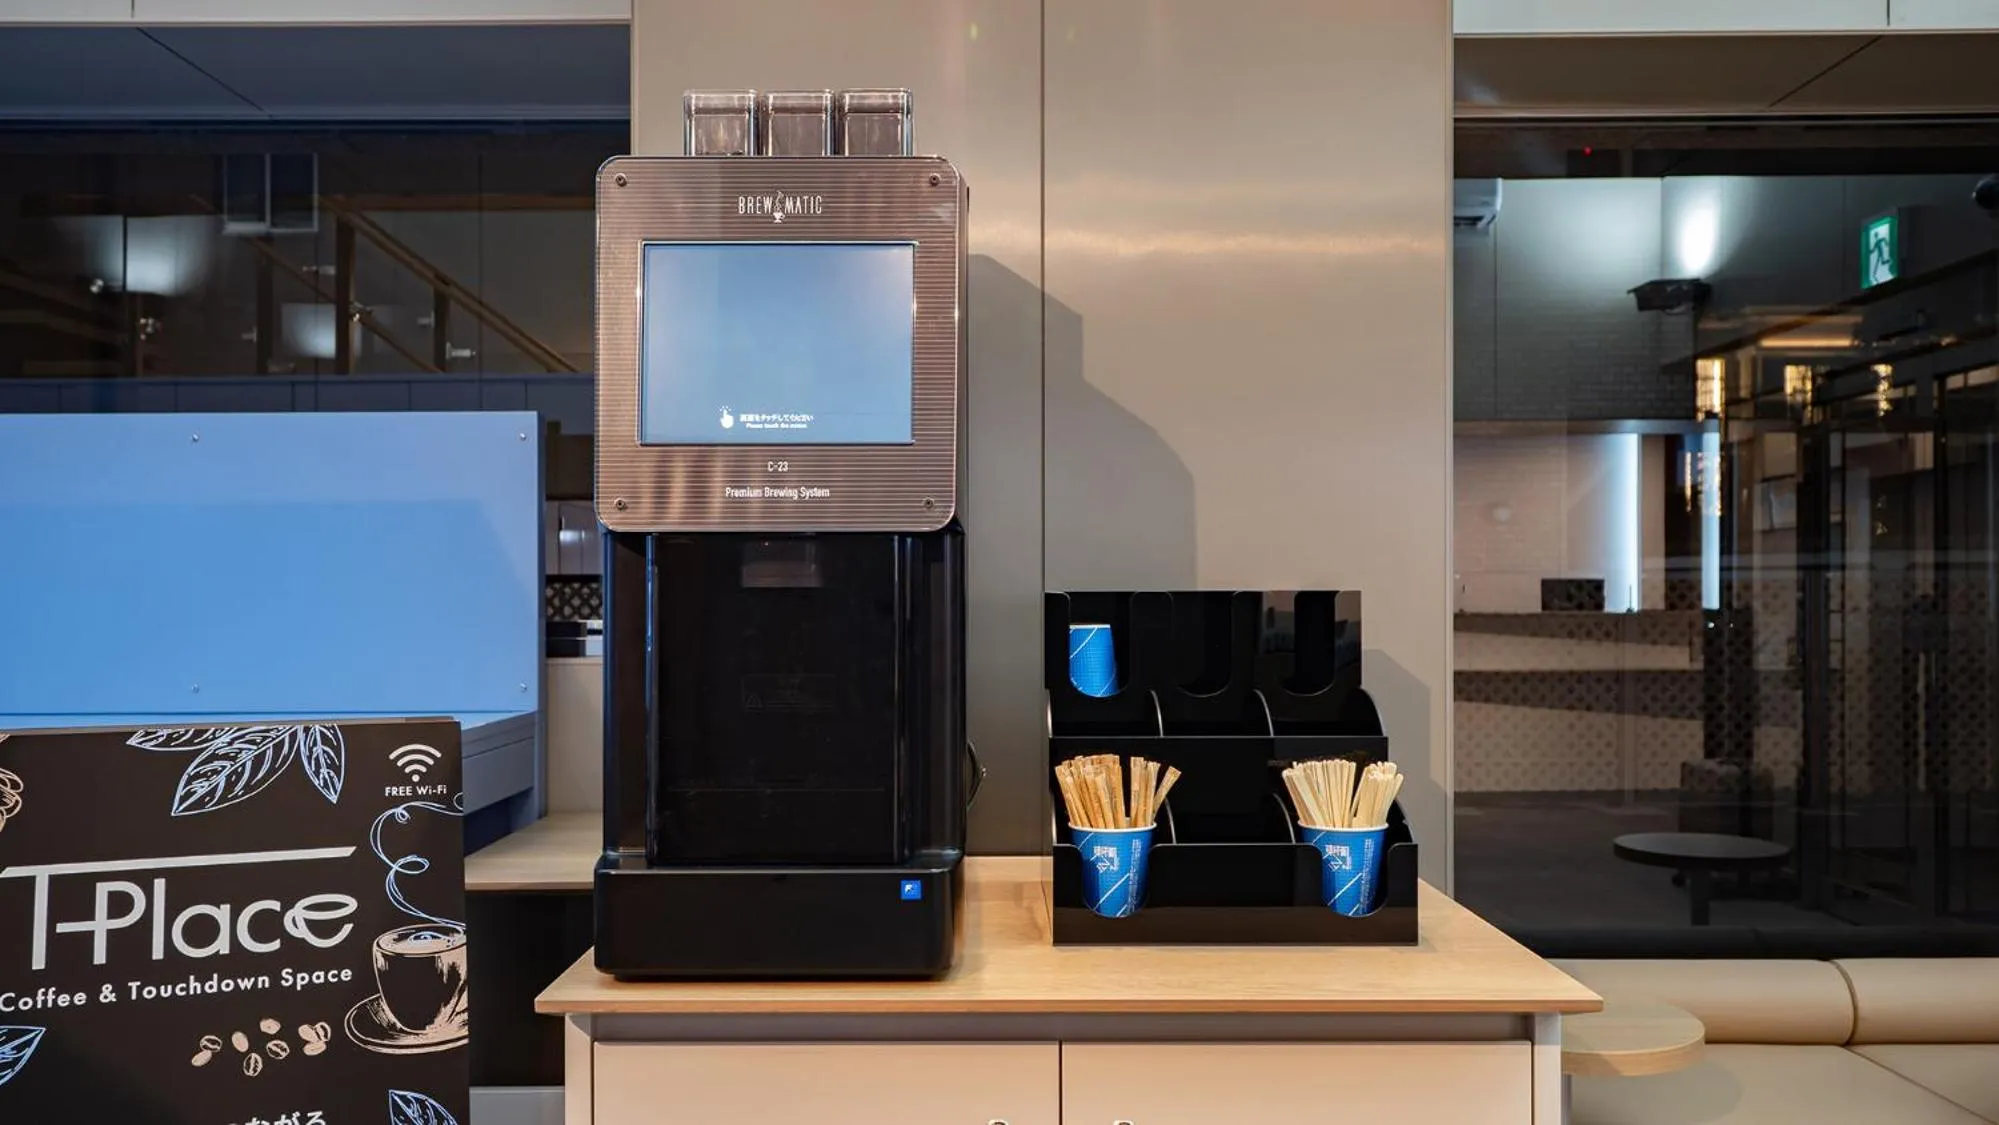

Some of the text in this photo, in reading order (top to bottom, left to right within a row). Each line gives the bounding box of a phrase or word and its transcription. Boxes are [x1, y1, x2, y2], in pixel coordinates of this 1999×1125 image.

[767, 461, 788, 472] C-23
[725, 486, 830, 500] Premium Brewing System
[385, 784, 447, 797] FREE Wi-Fi
[0, 967, 353, 1012] Coffee & Touchdown Space
